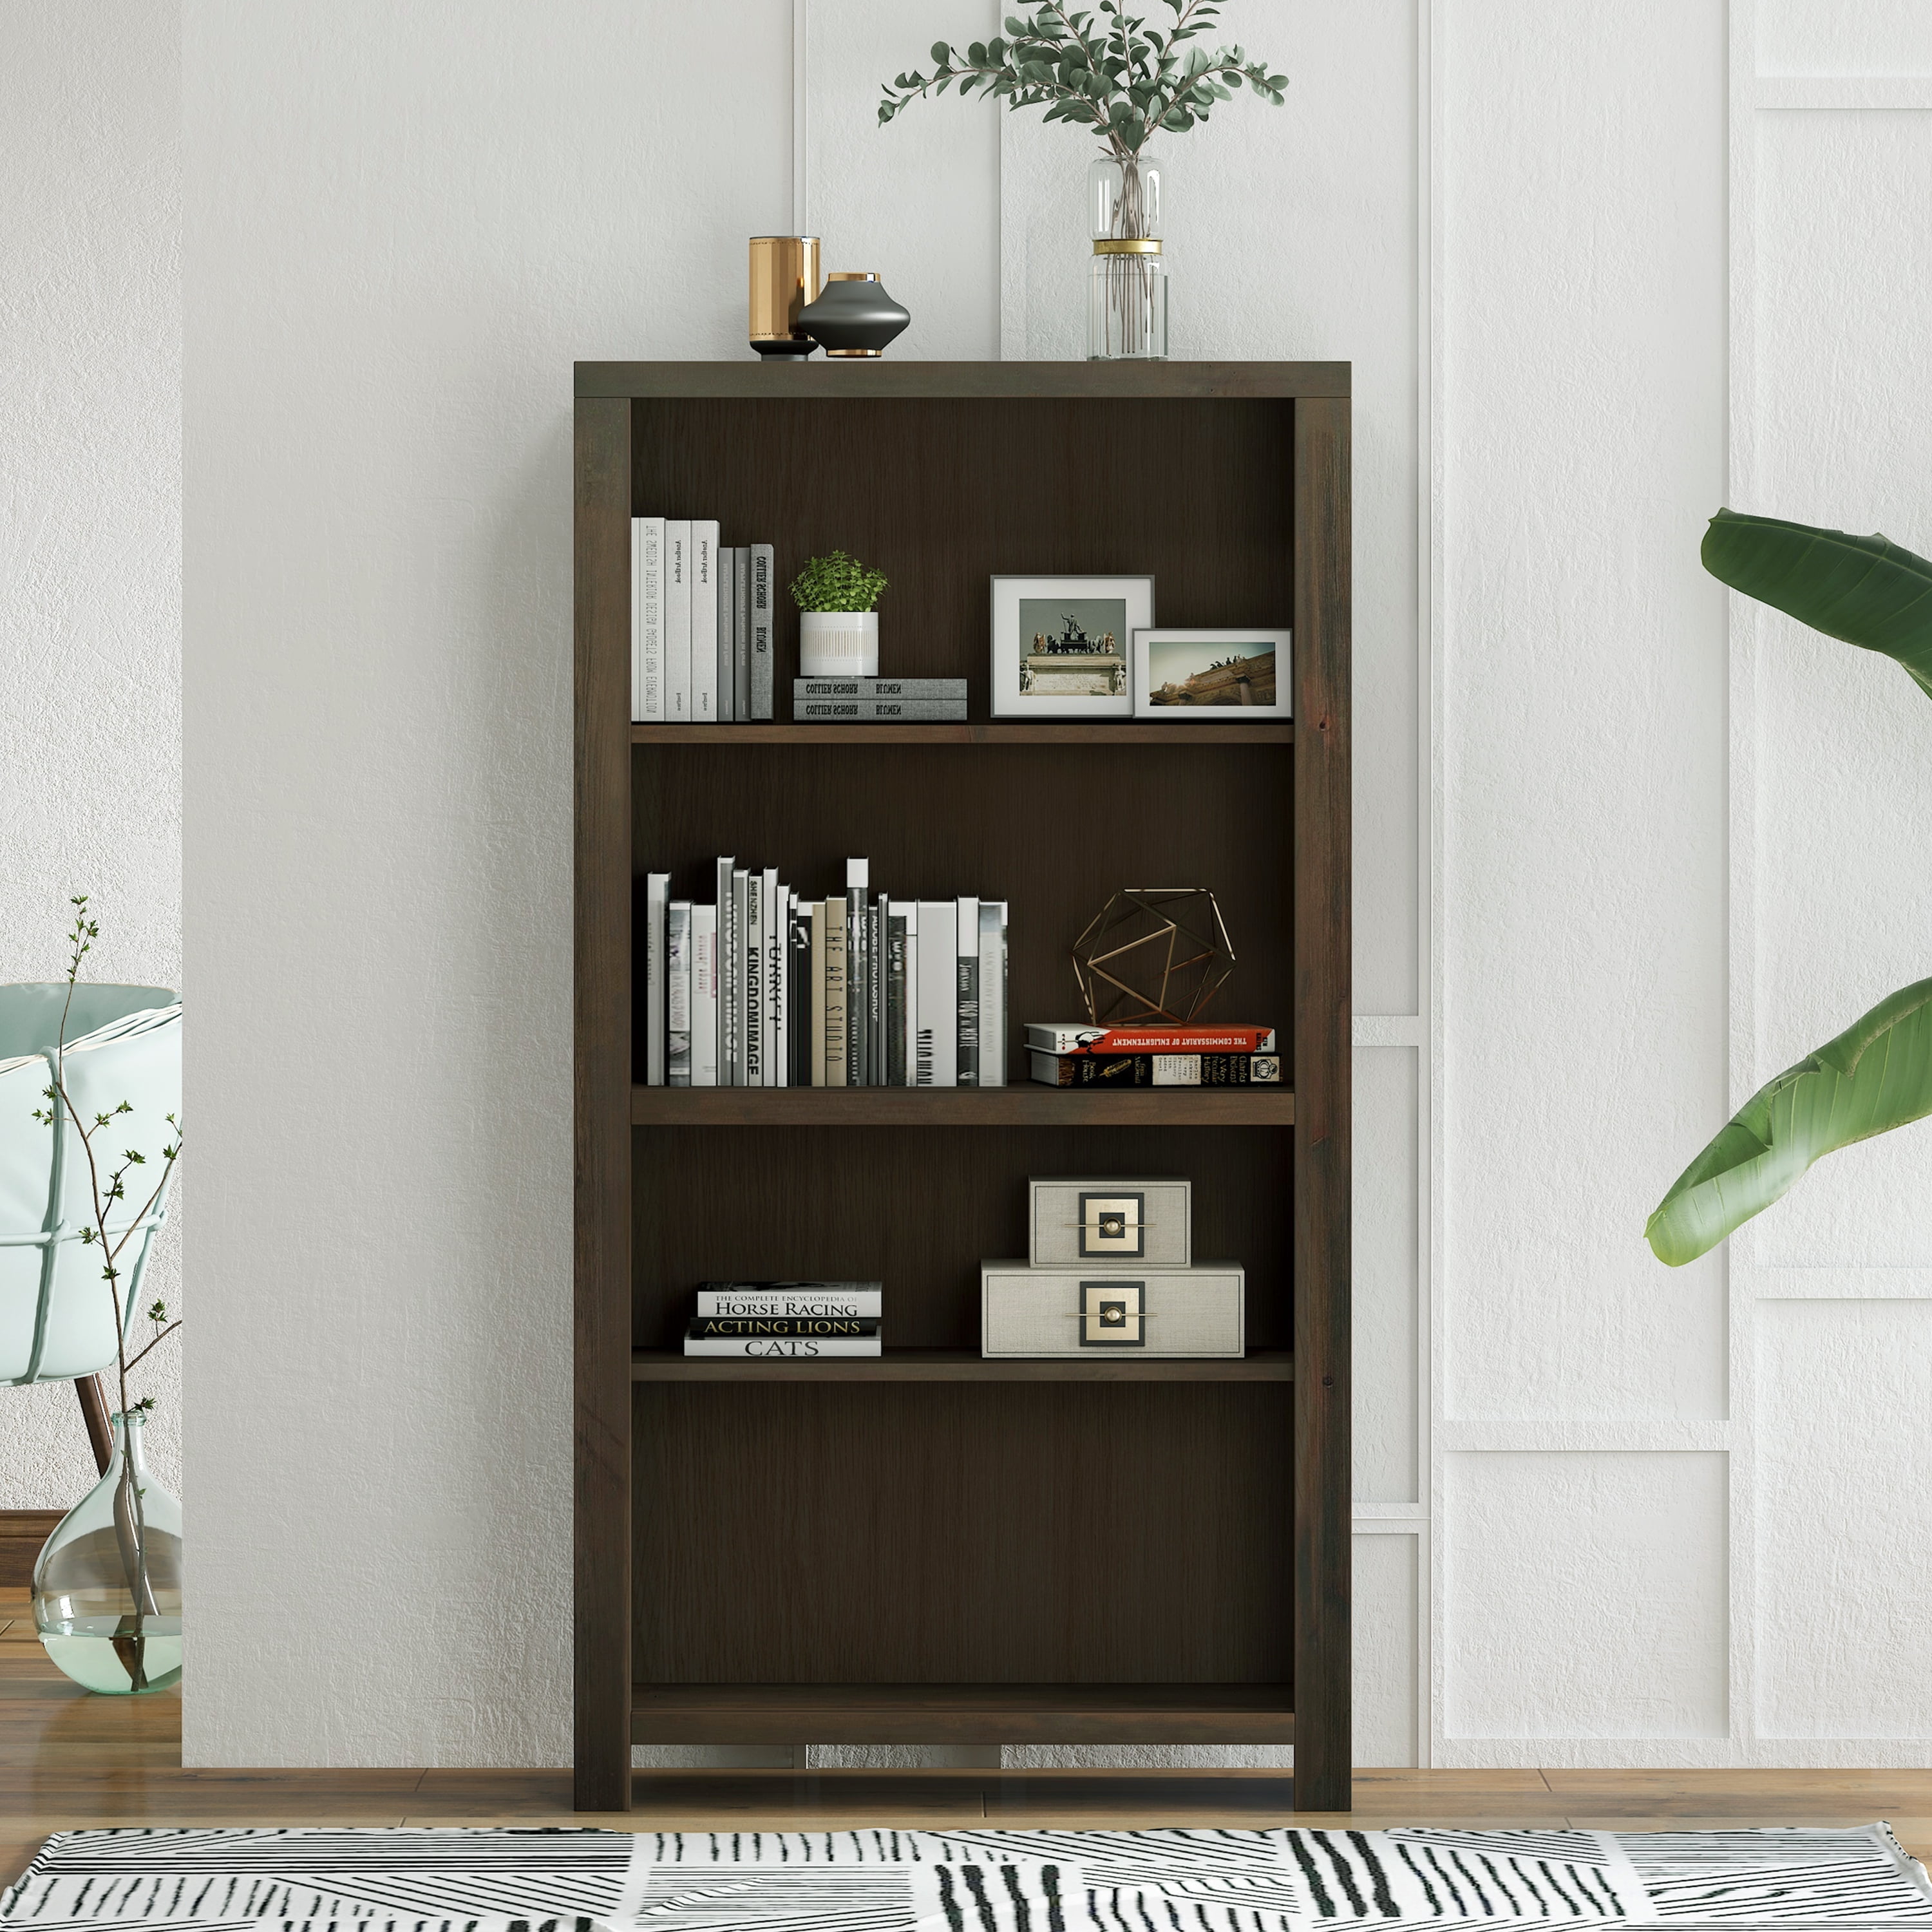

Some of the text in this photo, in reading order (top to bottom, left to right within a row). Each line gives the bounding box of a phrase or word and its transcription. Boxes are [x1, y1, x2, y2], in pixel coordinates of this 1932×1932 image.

[826, 926, 842, 1062] THE ART STUDIO
[748, 947, 759, 1075] KINGDOMIMAGE
[1239, 1056, 1247, 1083] Charles
[703, 1320, 860, 1333] ACTING LIONS
[744, 1341, 819, 1356] CATS
